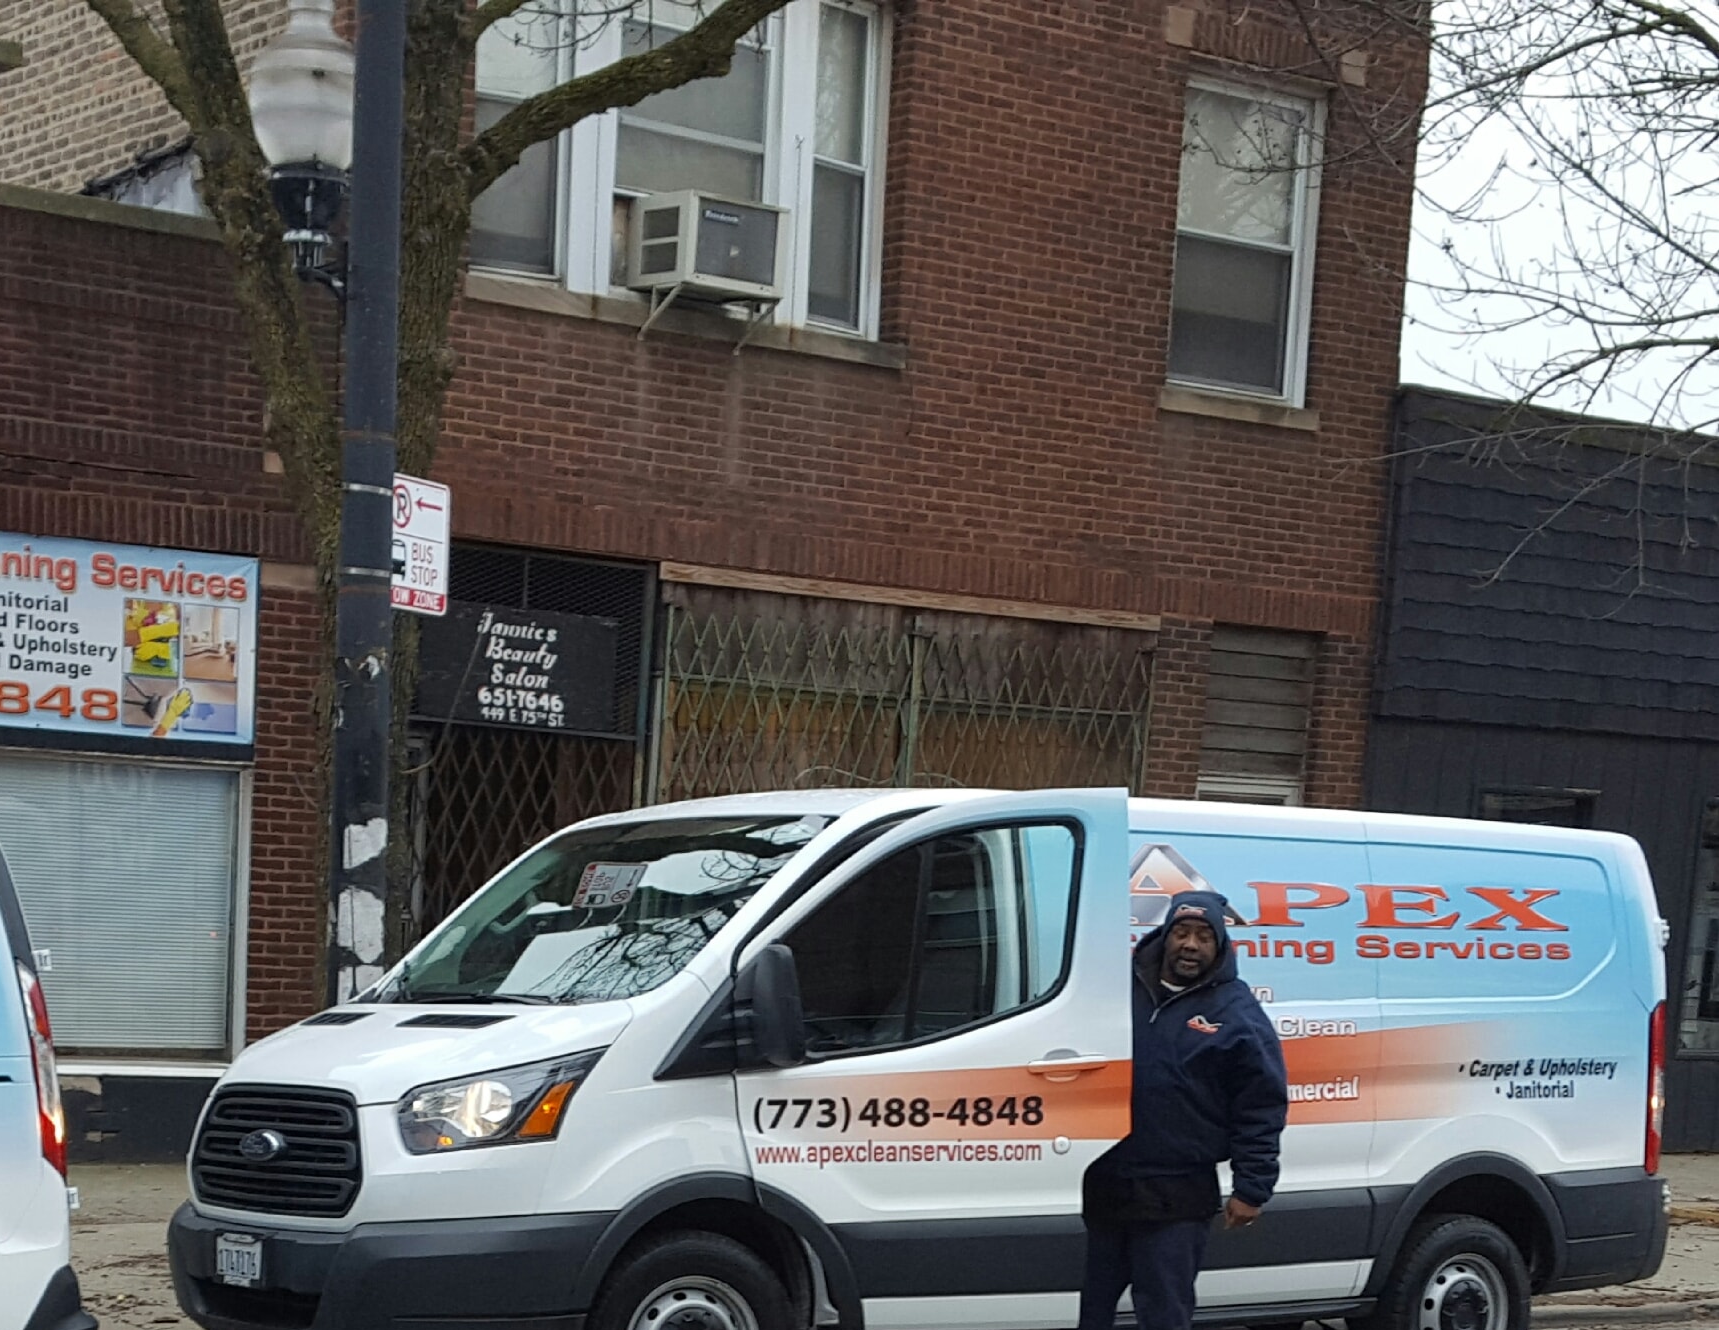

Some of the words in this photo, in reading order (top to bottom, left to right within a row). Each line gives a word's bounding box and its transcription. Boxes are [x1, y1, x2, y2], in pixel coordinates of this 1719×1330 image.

[412, 543, 435, 565] BUS
[90, 552, 248, 602] Services
[410, 565, 439, 587] STOP
[391, 588, 411, 604] OW
[412, 591, 442, 611] ZONE
[15, 614, 80, 635] Floors
[13, 635, 118, 663] Upholstery
[485, 635, 558, 670] Beauty
[8, 657, 93, 679] Damage
[490, 663, 549, 689] Salon
[477, 684, 564, 713] 651-7646
[481, 706, 505, 721] 449
[509, 708, 518, 723] E
[1355, 935, 1572, 960] Services
[1278, 1016, 1357, 1037] Clean
[1468, 1060, 1521, 1080] Carpet
[1524, 1059, 1535, 1074] &
[1539, 1058, 1618, 1079] Upholstery
[1286, 1075, 1361, 1102] mercial
[1506, 1080, 1575, 1099] Janitorial
[756, 1139, 1043, 1169] www.apexcleanservices.com
